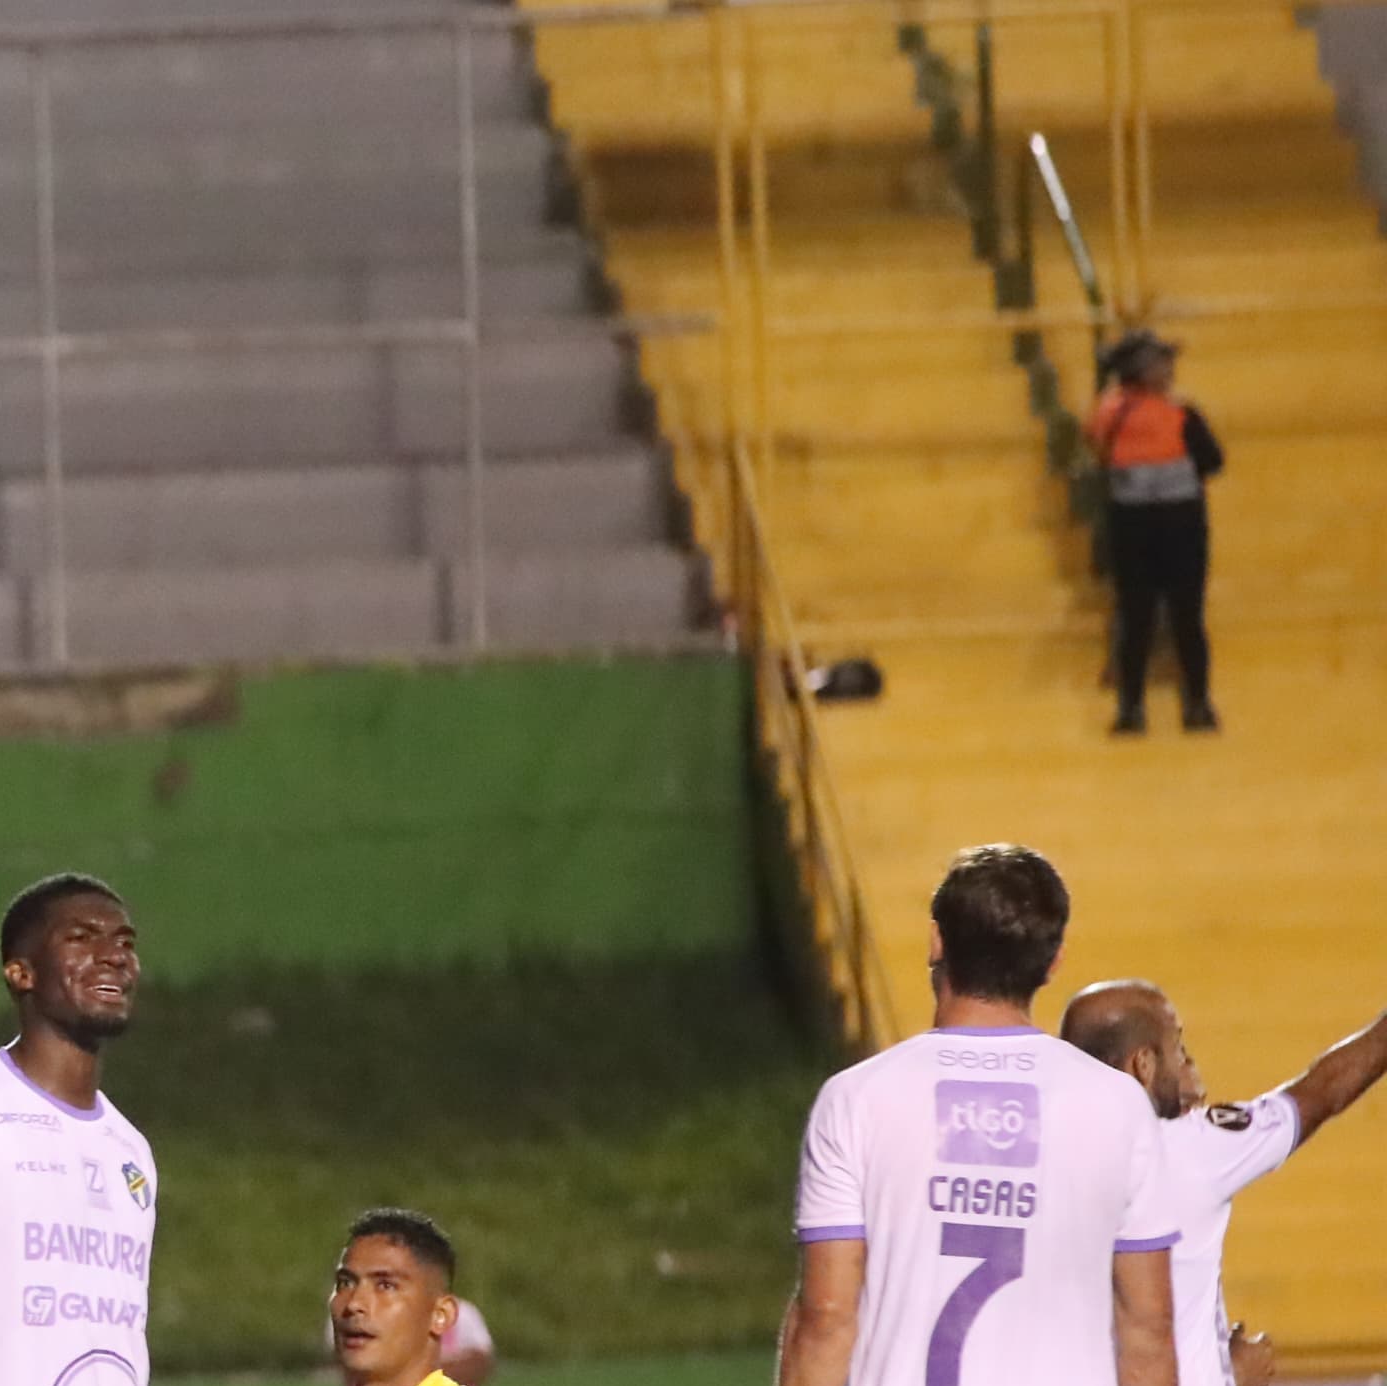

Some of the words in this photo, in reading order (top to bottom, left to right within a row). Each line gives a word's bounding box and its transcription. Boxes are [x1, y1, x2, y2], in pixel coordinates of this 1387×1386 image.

[938, 1050, 1035, 1071] sears
[15, 1161, 68, 1175] KELME
[929, 1176, 1037, 1218] CASAS
